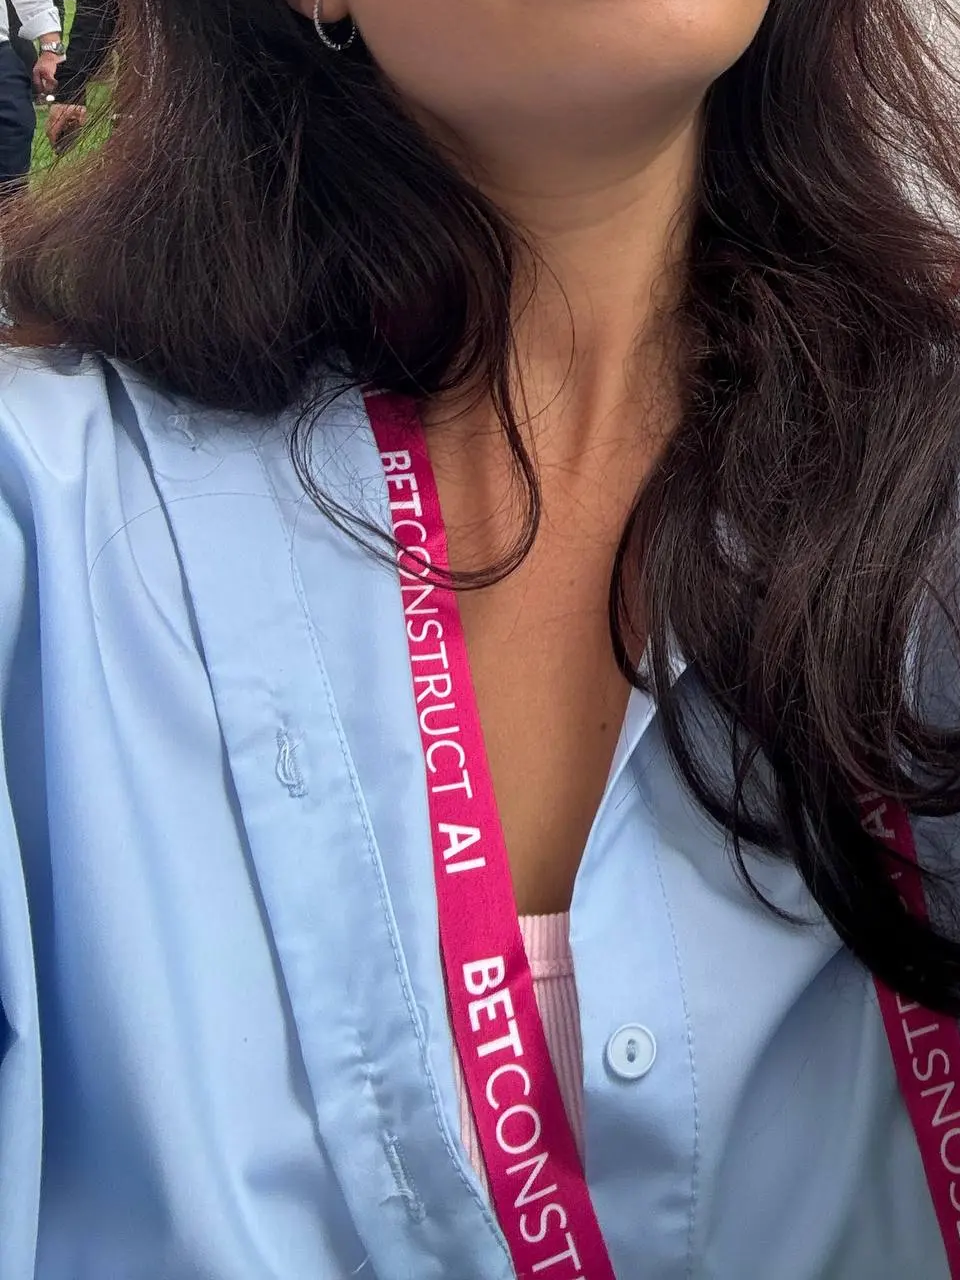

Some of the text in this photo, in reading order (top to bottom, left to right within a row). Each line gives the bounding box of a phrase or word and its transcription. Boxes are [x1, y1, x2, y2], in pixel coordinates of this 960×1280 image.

[380, 449, 586, 1280] BETCONSTRUCT AI BETCONST
